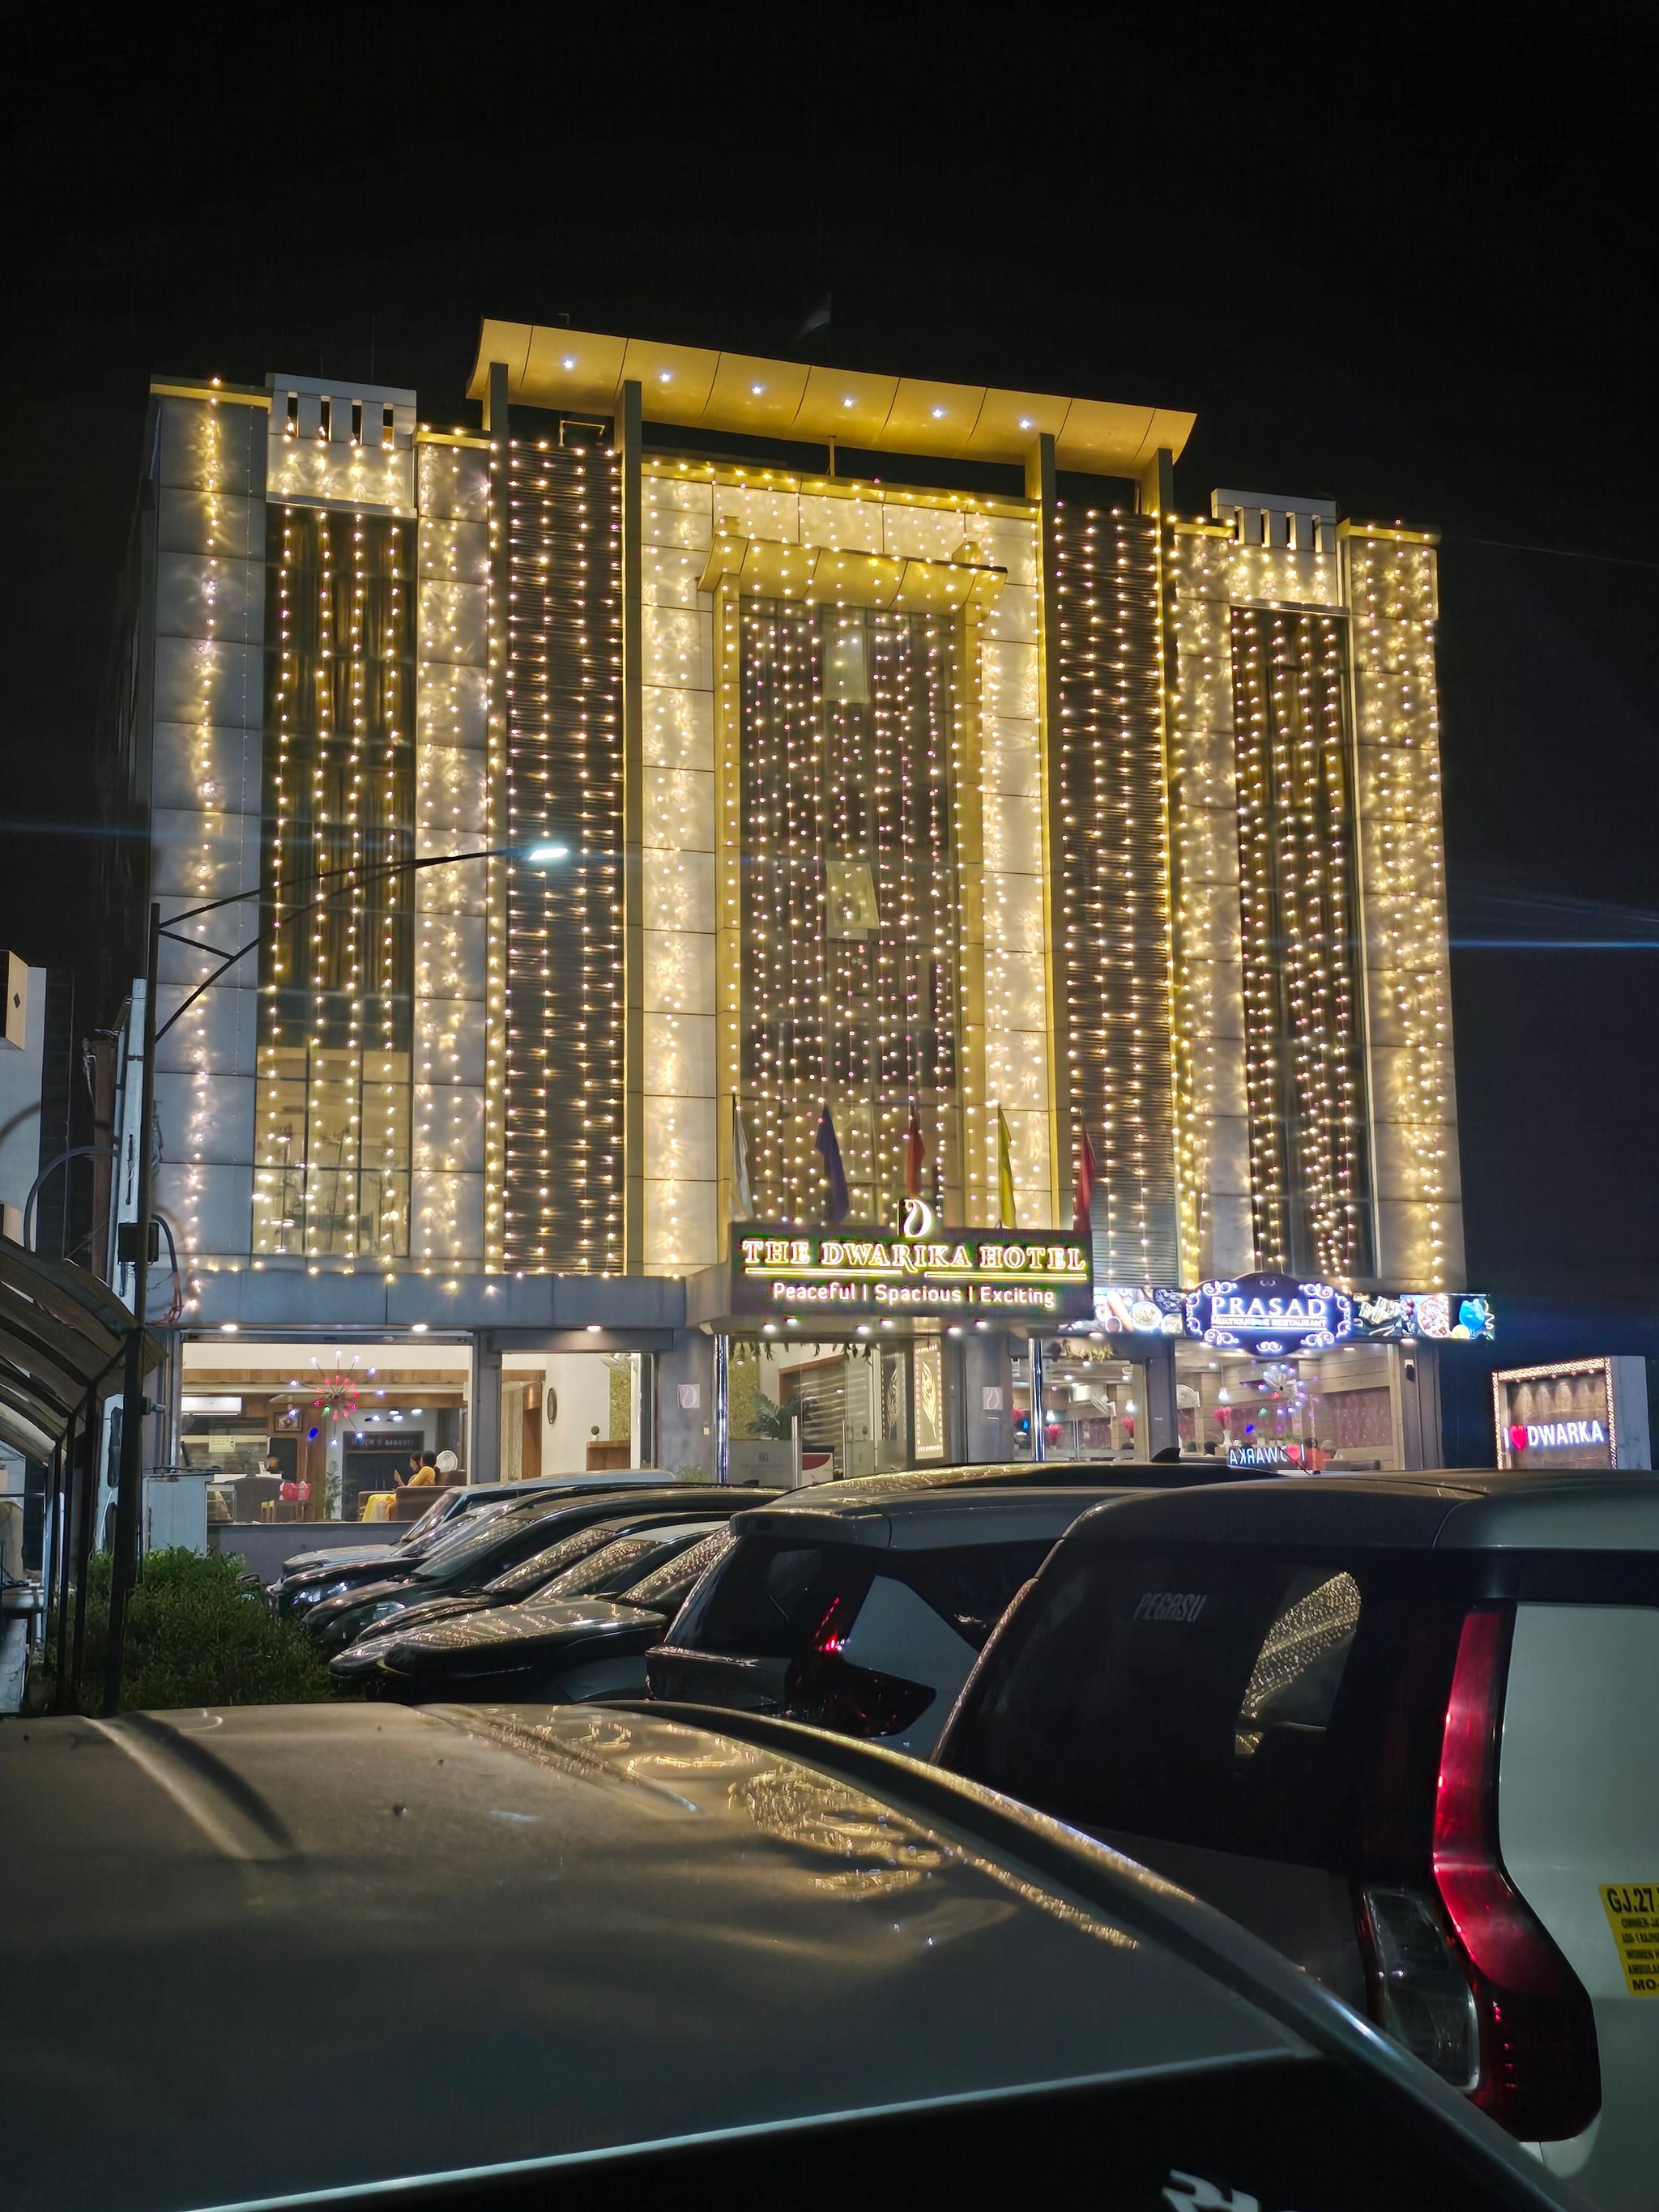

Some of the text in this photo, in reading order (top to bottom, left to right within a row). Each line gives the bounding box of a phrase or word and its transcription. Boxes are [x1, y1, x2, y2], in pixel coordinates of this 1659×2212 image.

[741, 1240, 1087, 1272] THE DWARIKA HOTEL
[773, 1282, 855, 1301] Peaceful
[874, 1284, 962, 1306] Spacious
[979, 1286, 1056, 1309] Exciting
[1211, 1296, 1327, 1317] PRASAD
[1526, 1420, 1605, 1447] DWARKA
